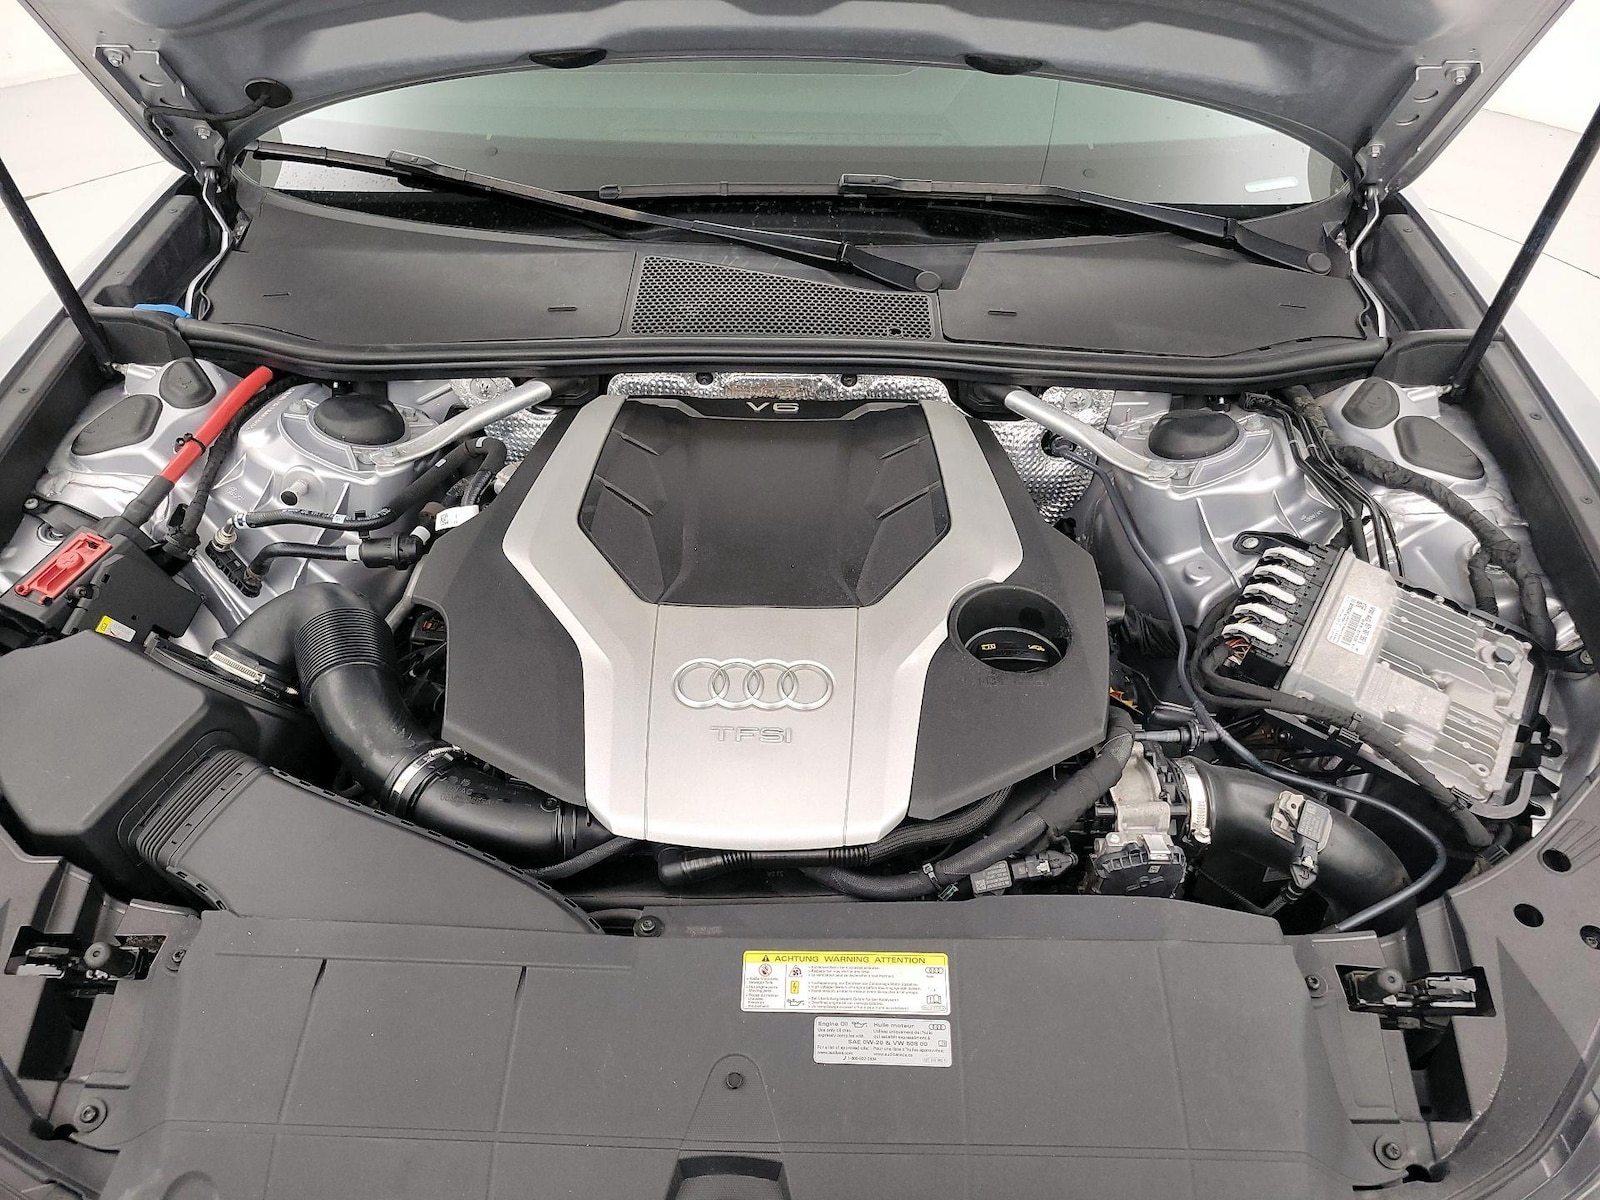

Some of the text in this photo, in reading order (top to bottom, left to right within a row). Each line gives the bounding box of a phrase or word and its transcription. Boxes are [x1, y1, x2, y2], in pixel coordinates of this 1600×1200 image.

[746, 401, 800, 413] V6
[709, 725, 792, 743] TFSI
[774, 955, 926, 964] ACHTUNG WARNING ATTENTION
